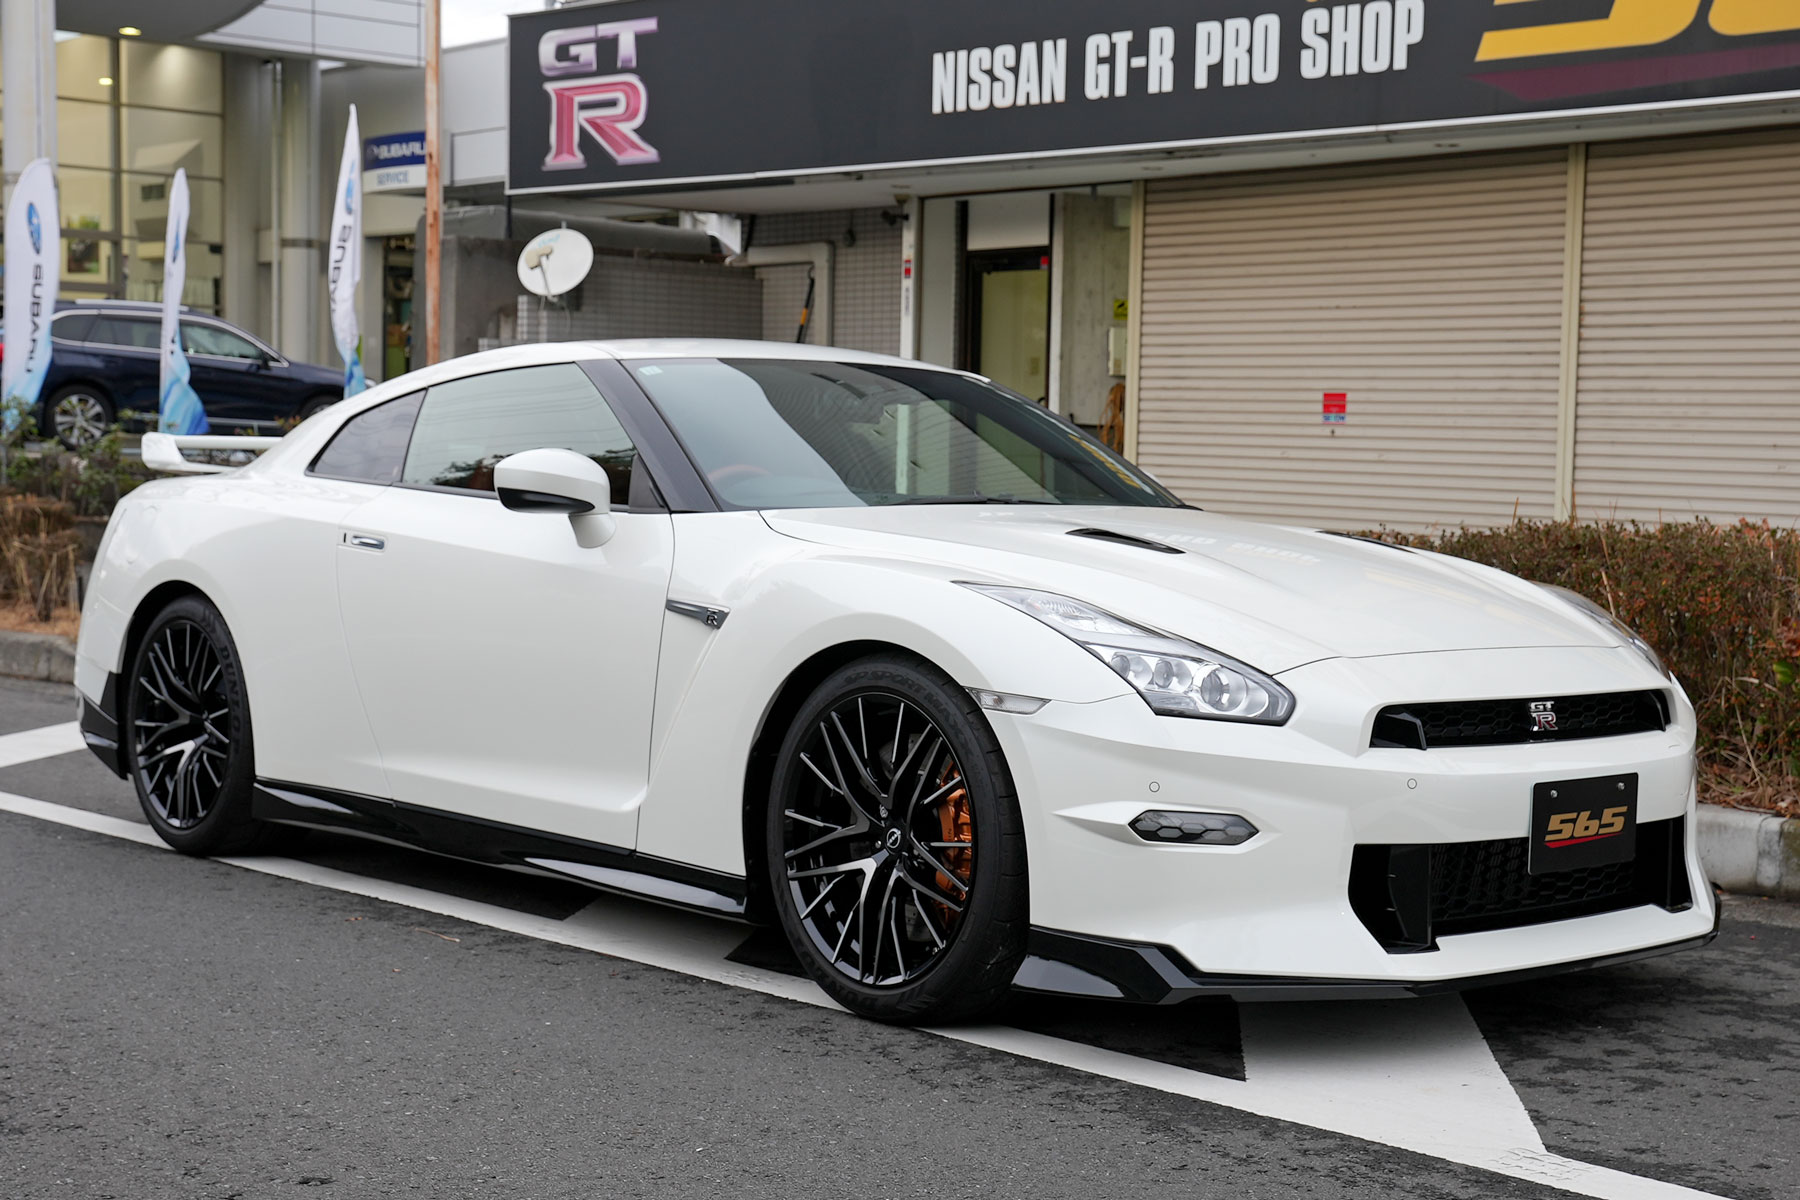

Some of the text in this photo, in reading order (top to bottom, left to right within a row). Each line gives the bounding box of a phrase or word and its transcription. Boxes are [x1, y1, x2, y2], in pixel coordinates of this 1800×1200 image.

[538, 17, 659, 77] GT
[932, 39, 1067, 114] NISSAN
[1084, 26, 1175, 100] GT-R
[1195, 14, 1281, 90] PRO
[1301, 0, 1425, 79] SHOP
[542, 73, 660, 171] R
[25, 263, 45, 374] SUBARU
[218, 645, 242, 755] DUNLOP
[870, 670, 926, 694] SPORT
[1530, 701, 1555, 711] GT
[1530, 711, 1559, 731] R
[1544, 806, 1628, 841] 565
